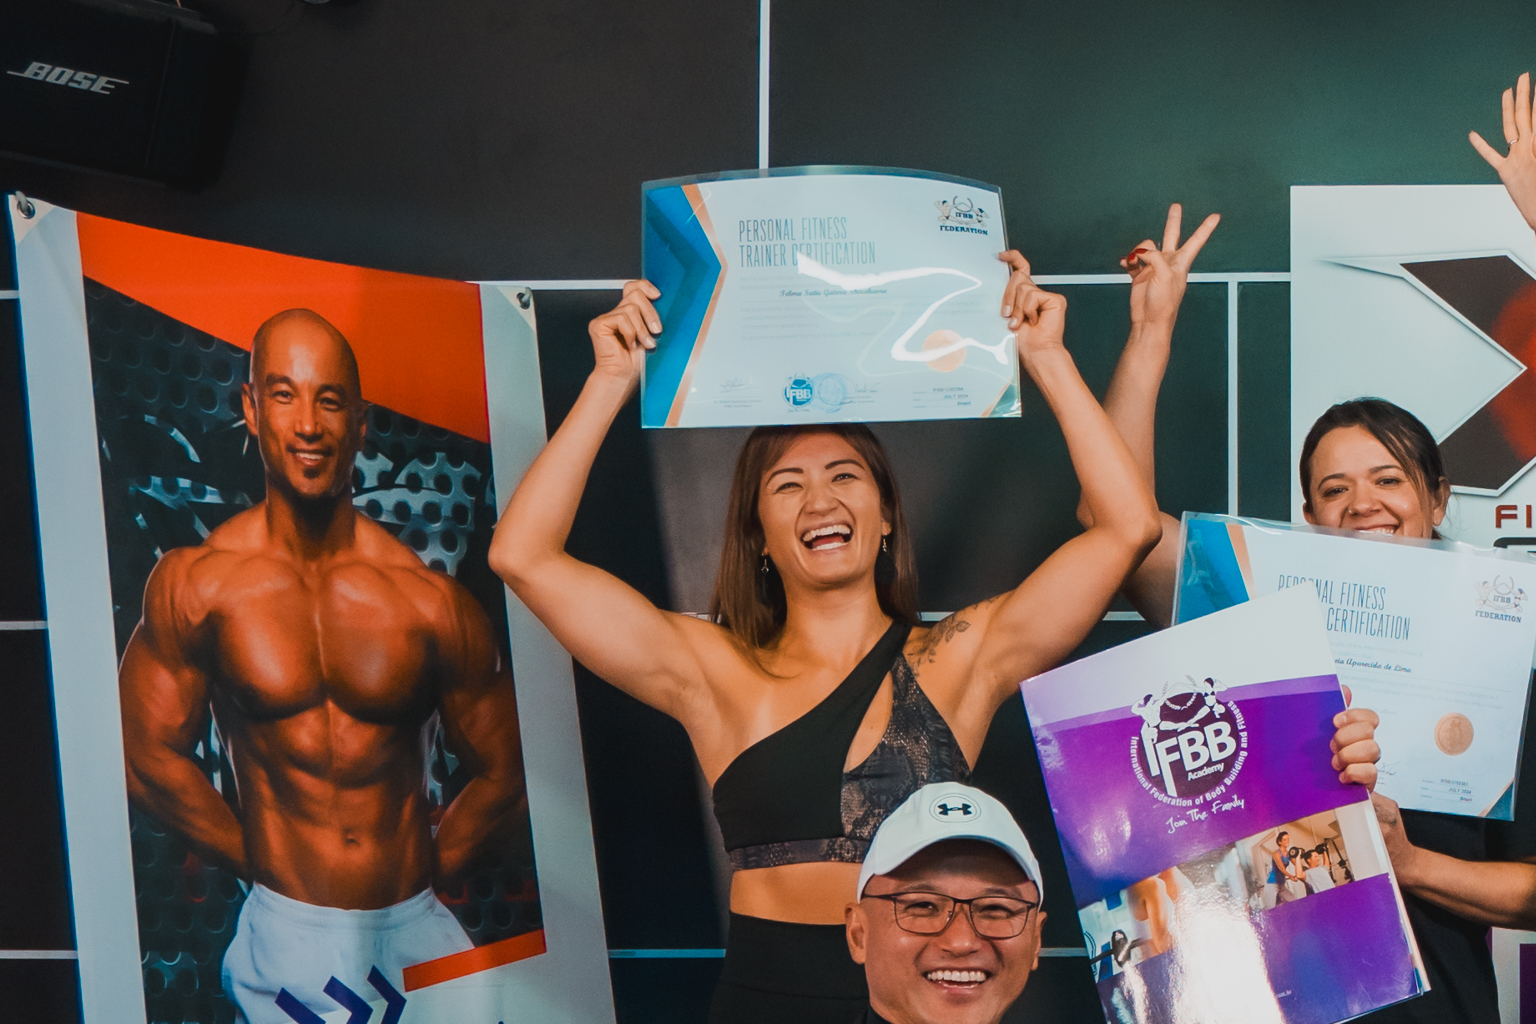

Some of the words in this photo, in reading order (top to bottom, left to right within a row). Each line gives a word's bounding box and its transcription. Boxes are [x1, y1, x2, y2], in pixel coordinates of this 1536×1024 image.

[7, 61, 129, 95] BOSE
[739, 218, 796, 242] PERSONAL
[802, 216, 847, 240] FITNESS
[939, 225, 988, 235] FEDERATION
[739, 244, 786, 268] TRAINER
[1340, 582, 1386, 611] FITNESS
[1326, 607, 1411, 641] CERTIFICATION
[1474, 610, 1522, 623] FEDERATION
[1228, 700, 1246, 730] Fitness
[1239, 732, 1248, 748] and
[1130, 736, 1151, 791] International
[1140, 721, 1236, 797] IFBB
[1187, 762, 1225, 781] Academy
[1224, 750, 1248, 786] Building
[1150, 787, 1192, 807] Federation
[1195, 797, 1204, 806] of
[1205, 785, 1226, 801] Body
[1166, 815, 1187, 834] Join
[1186, 809, 1208, 822] The
[1211, 795, 1245, 814] Family
